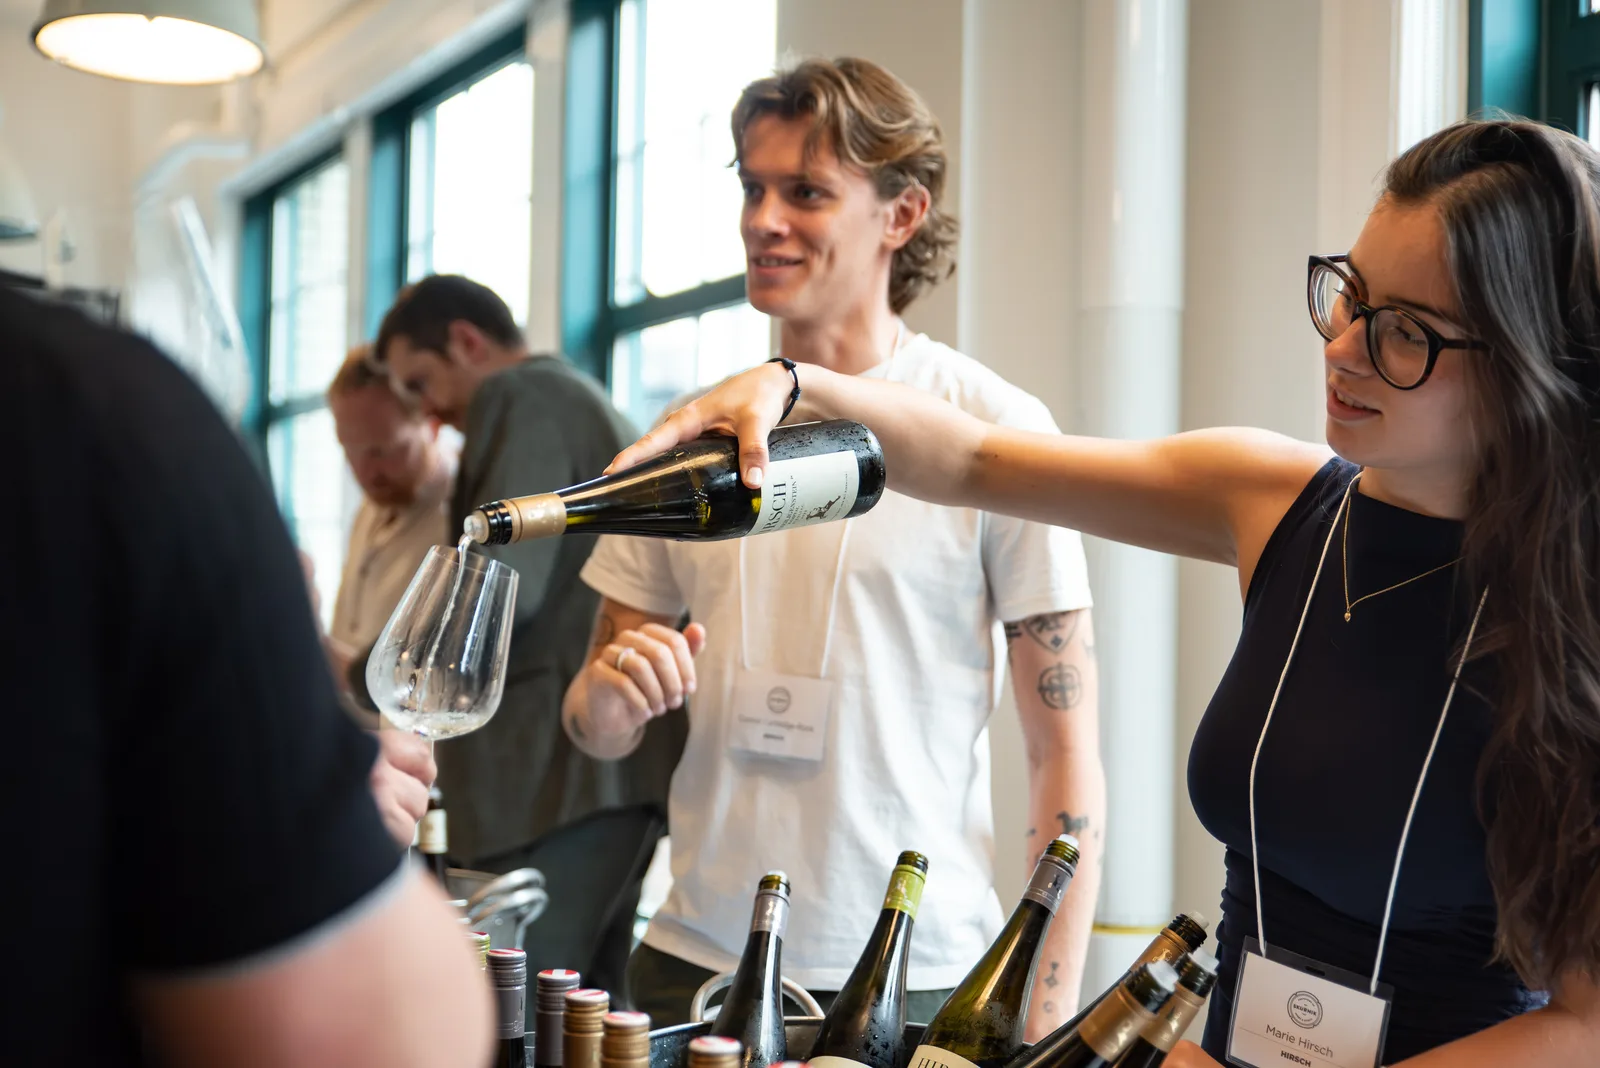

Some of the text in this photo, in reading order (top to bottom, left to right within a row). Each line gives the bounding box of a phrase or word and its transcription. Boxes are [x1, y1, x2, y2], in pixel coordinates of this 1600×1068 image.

[759, 483, 786, 532] IRSCH
[1293, 1003, 1317, 1017] SKURNIK
[1266, 1024, 1334, 1058] Marie Hirsch
[1280, 1050, 1311, 1067] HIRSCH
